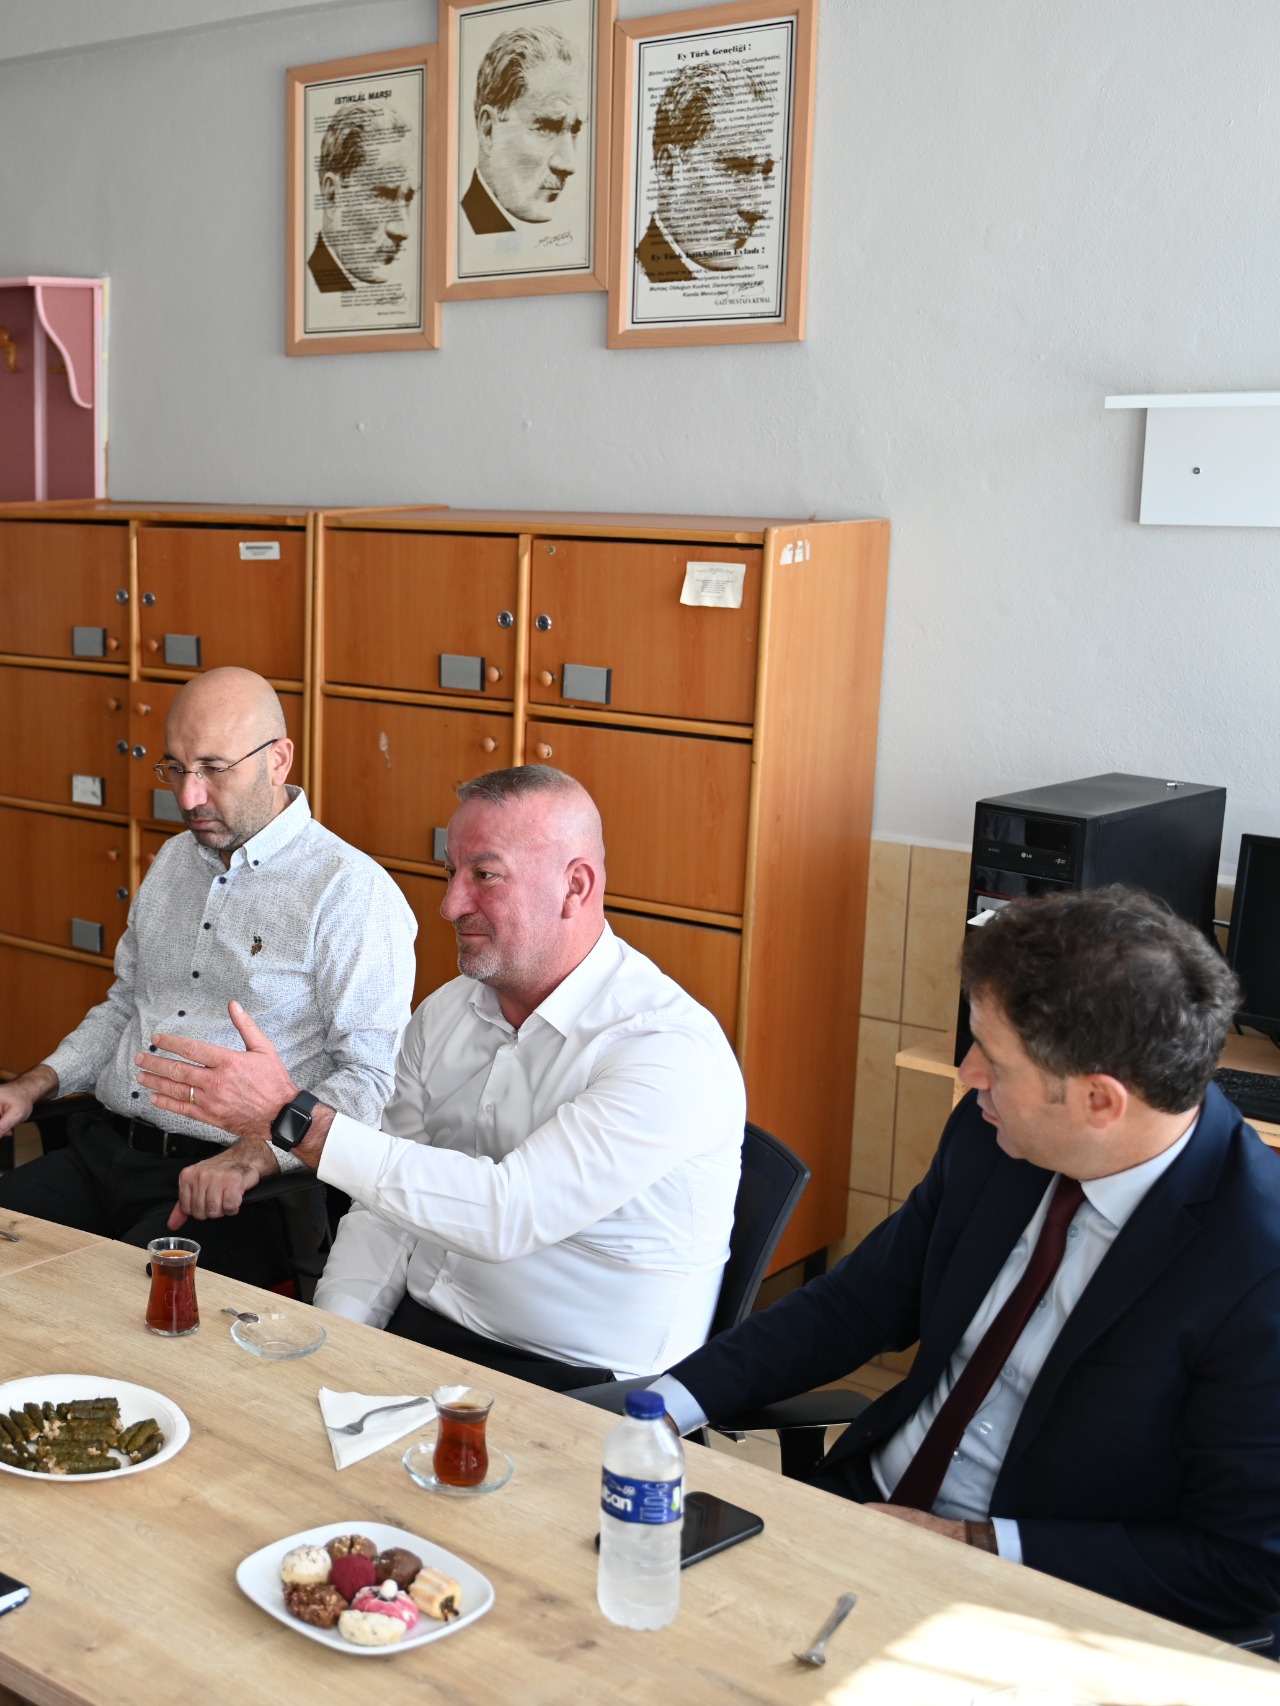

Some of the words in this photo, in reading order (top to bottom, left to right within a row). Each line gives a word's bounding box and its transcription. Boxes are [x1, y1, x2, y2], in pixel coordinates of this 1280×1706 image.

[677, 53, 687, 61] Ey
[691, 50, 710, 59] Türk
[712, 44, 746, 55] Gençliği
